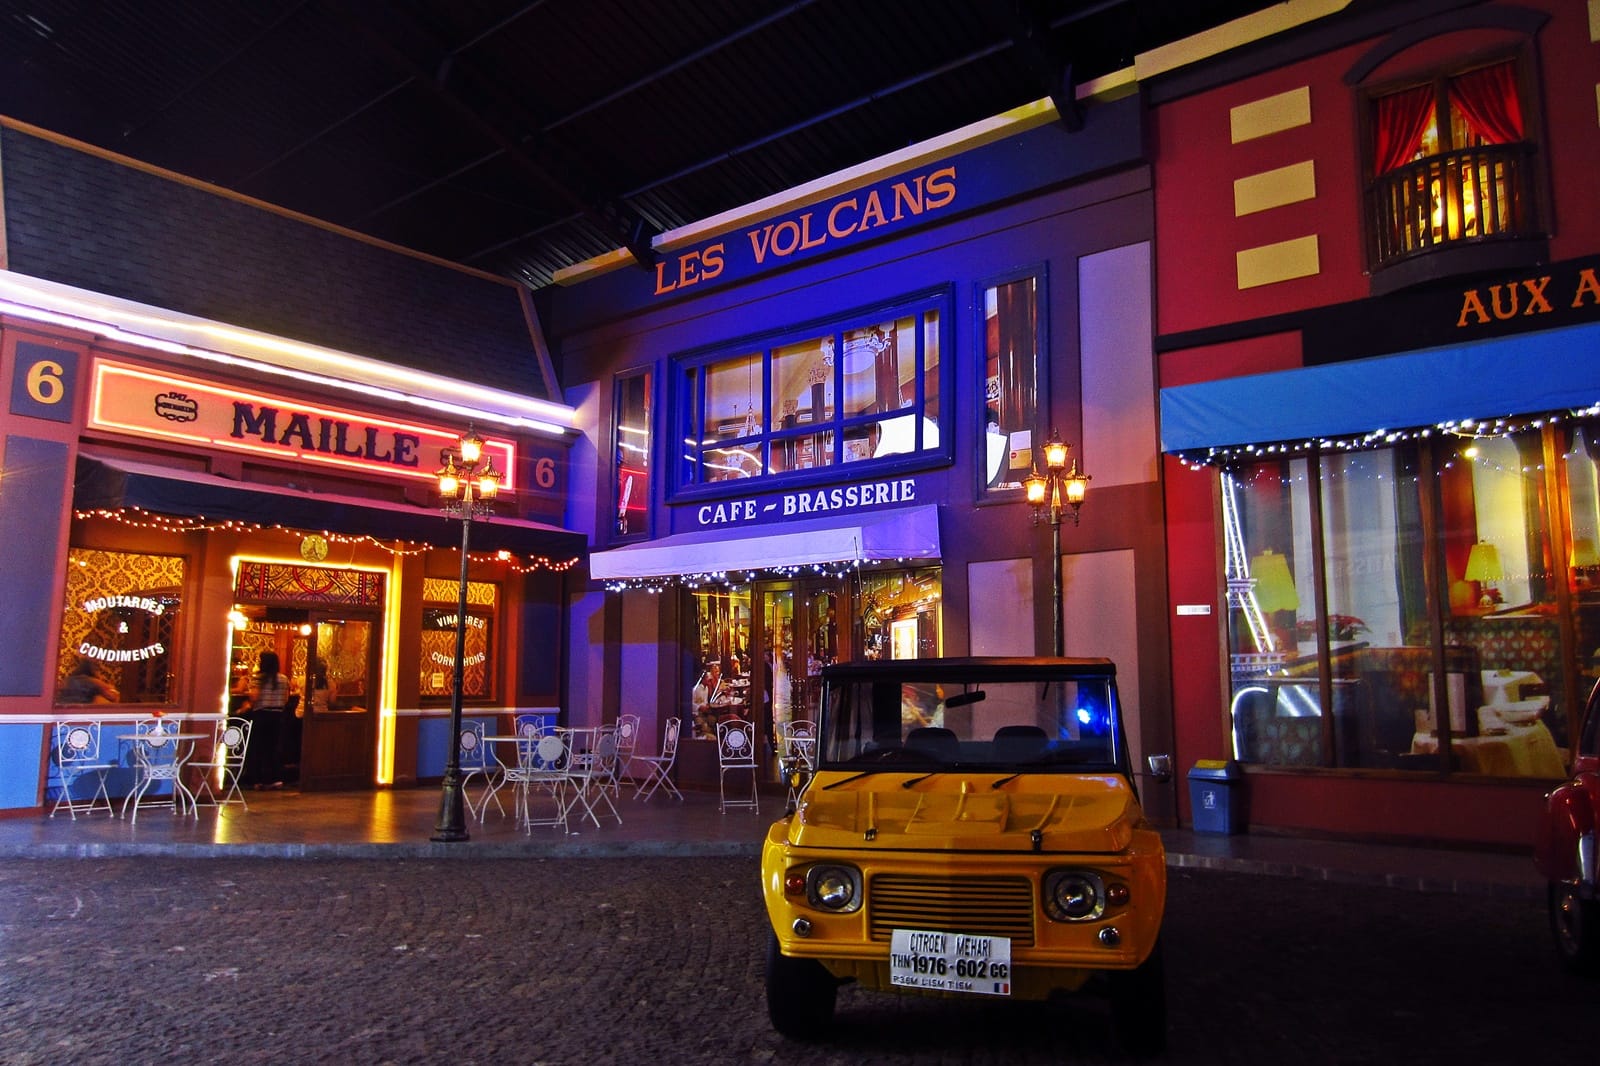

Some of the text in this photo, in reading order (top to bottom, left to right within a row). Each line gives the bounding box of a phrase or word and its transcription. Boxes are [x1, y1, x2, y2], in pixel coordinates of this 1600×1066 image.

[654, 166, 957, 295] LES VOLCANS
[1456, 276, 1554, 327] AUX
[27, 360, 64, 404] 6
[230, 401, 420, 467] MAILLE
[535, 457, 555, 488] 6
[698, 499, 757, 525] CAFE
[783, 479, 916, 516] BRASSERIE
[84, 595, 165, 616] MOUTARDES
[119, 621, 129, 634] &
[436, 614, 485, 630] VINARES
[79, 642, 165, 662] CONDIMENTS
[431, 651, 486, 667] CORNHONS
[909, 933, 992, 957] CITROEN MEHARI
[891, 953, 911, 968] THN
[911, 955, 947, 976] 1976
[956, 959, 987, 978] 602
